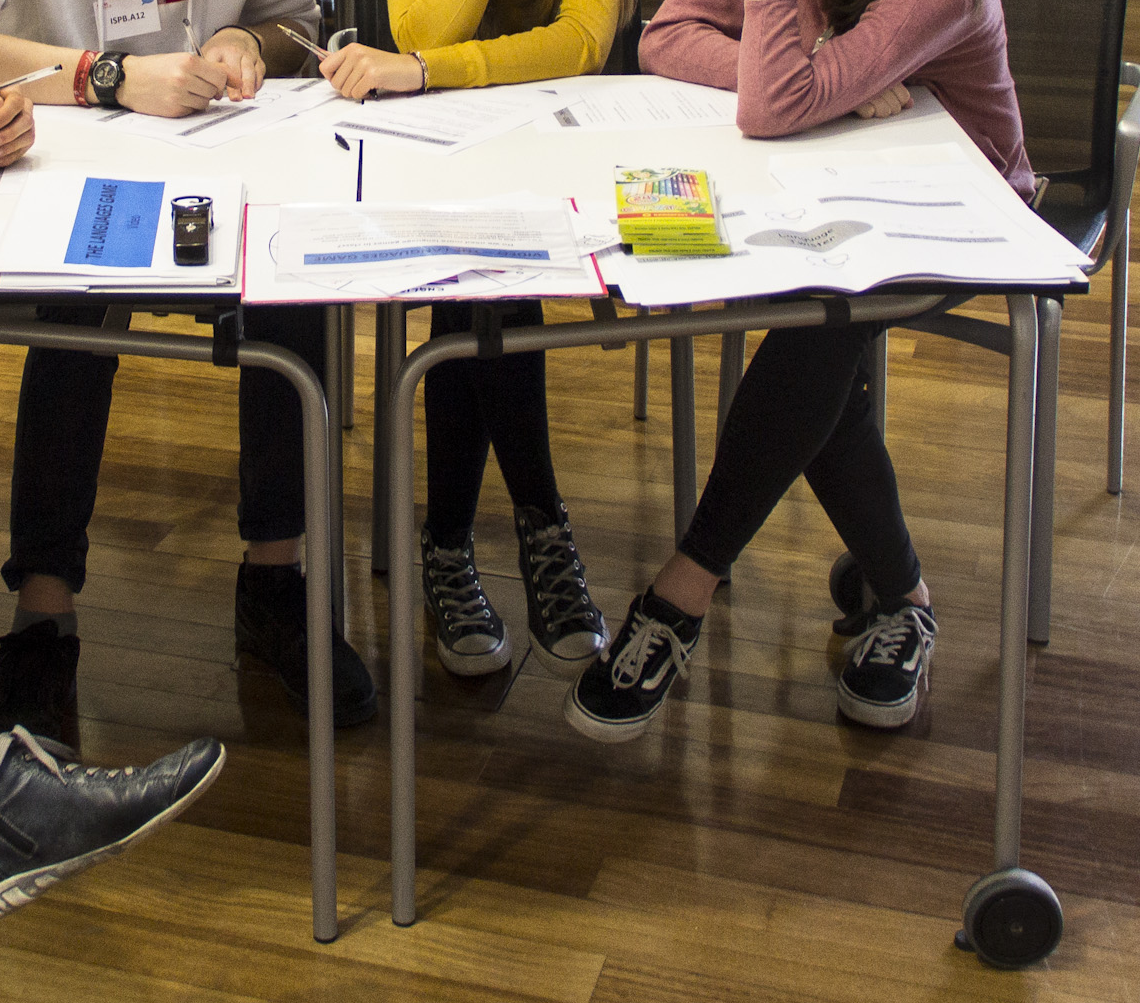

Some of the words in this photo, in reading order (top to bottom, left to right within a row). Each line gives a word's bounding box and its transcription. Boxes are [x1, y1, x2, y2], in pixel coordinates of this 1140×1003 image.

[110, 11, 145, 25] ISPB.A12
[98, 183, 118, 203] GAME
[89, 204, 113, 244] LANGUAGES
[85, 244, 104, 259] THE
